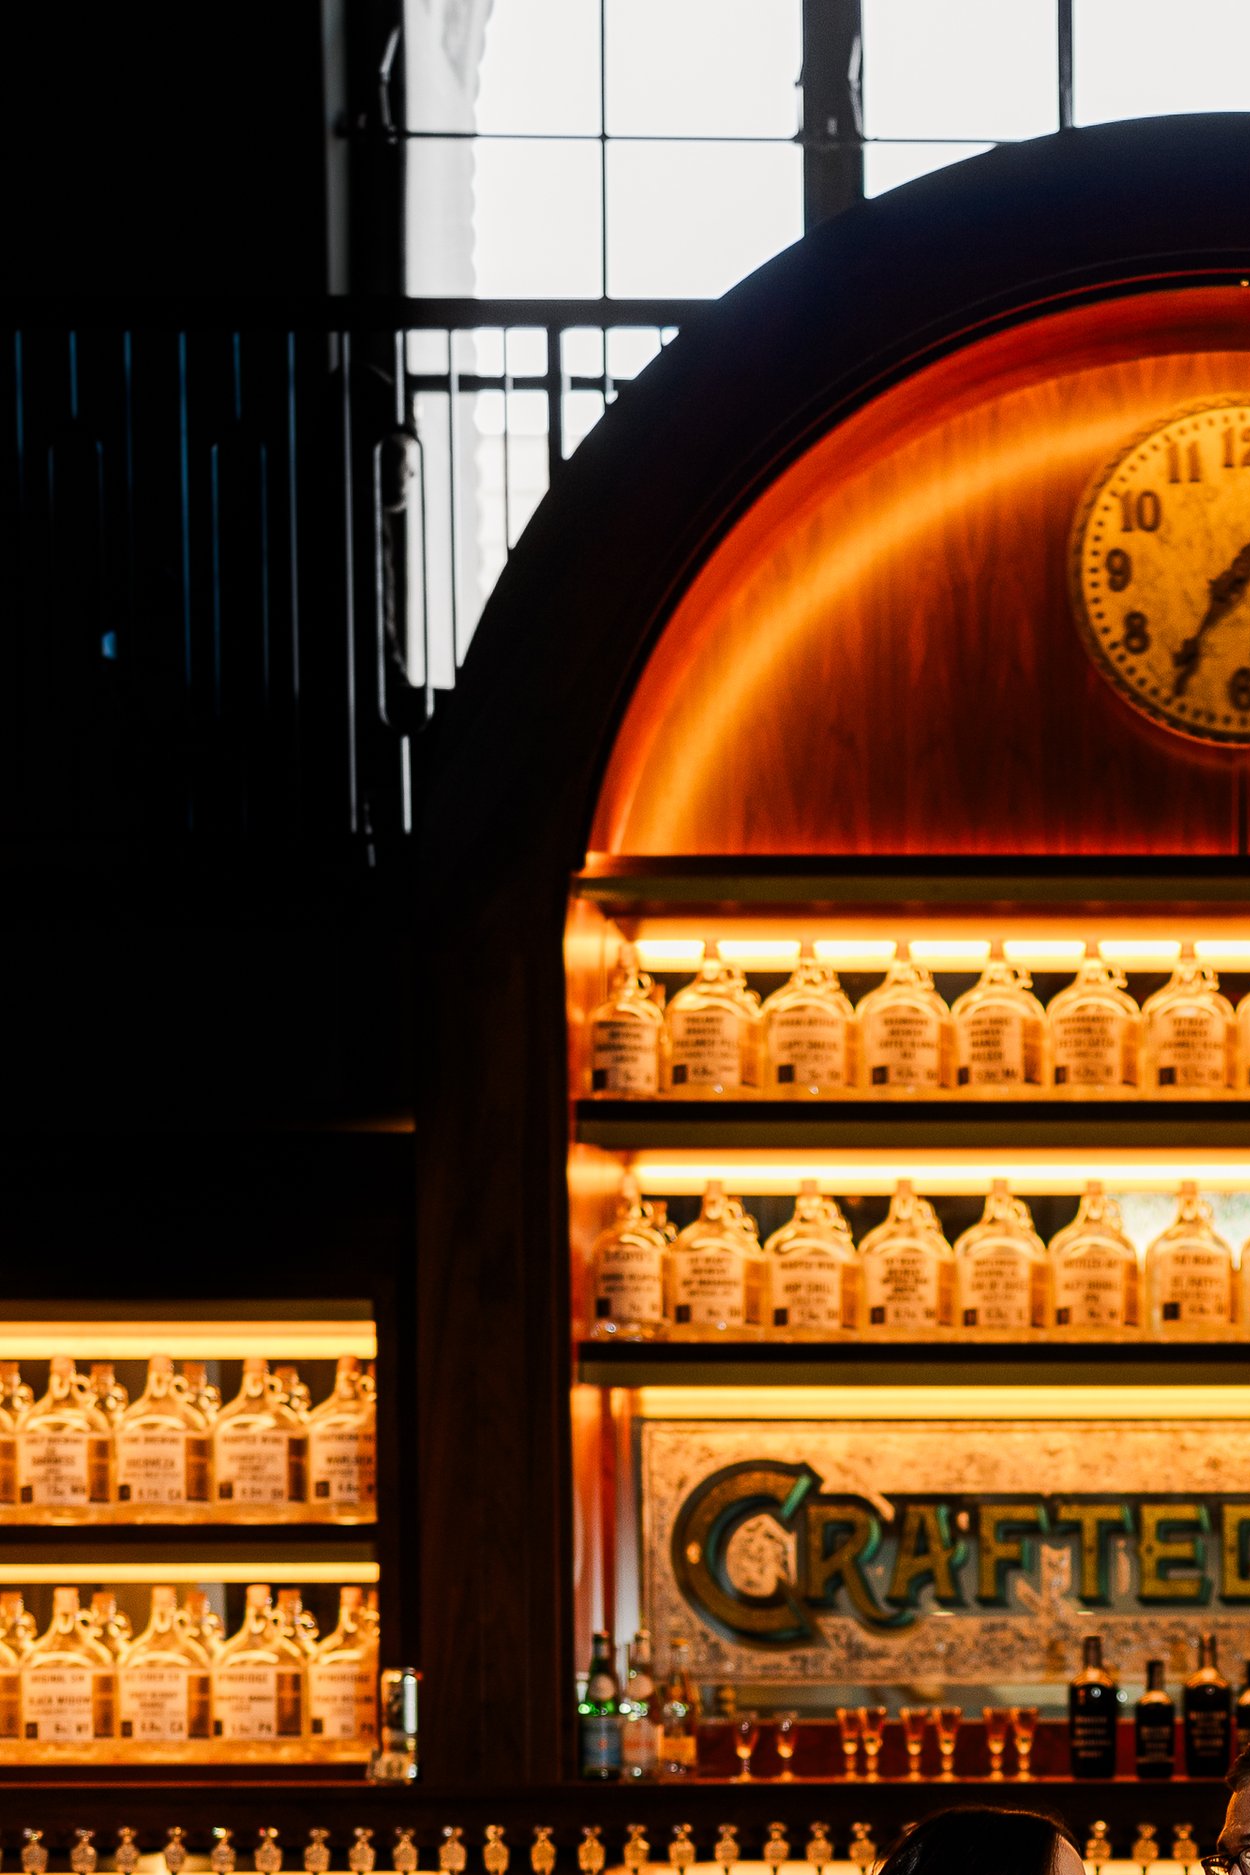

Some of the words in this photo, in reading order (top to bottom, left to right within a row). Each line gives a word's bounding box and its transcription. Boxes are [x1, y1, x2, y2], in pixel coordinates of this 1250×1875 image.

[1168, 441, 1203, 483] 11
[1120, 489, 1162, 533] 10
[1105, 548, 1133, 592] 9
[1122, 611, 1151, 655] 8
